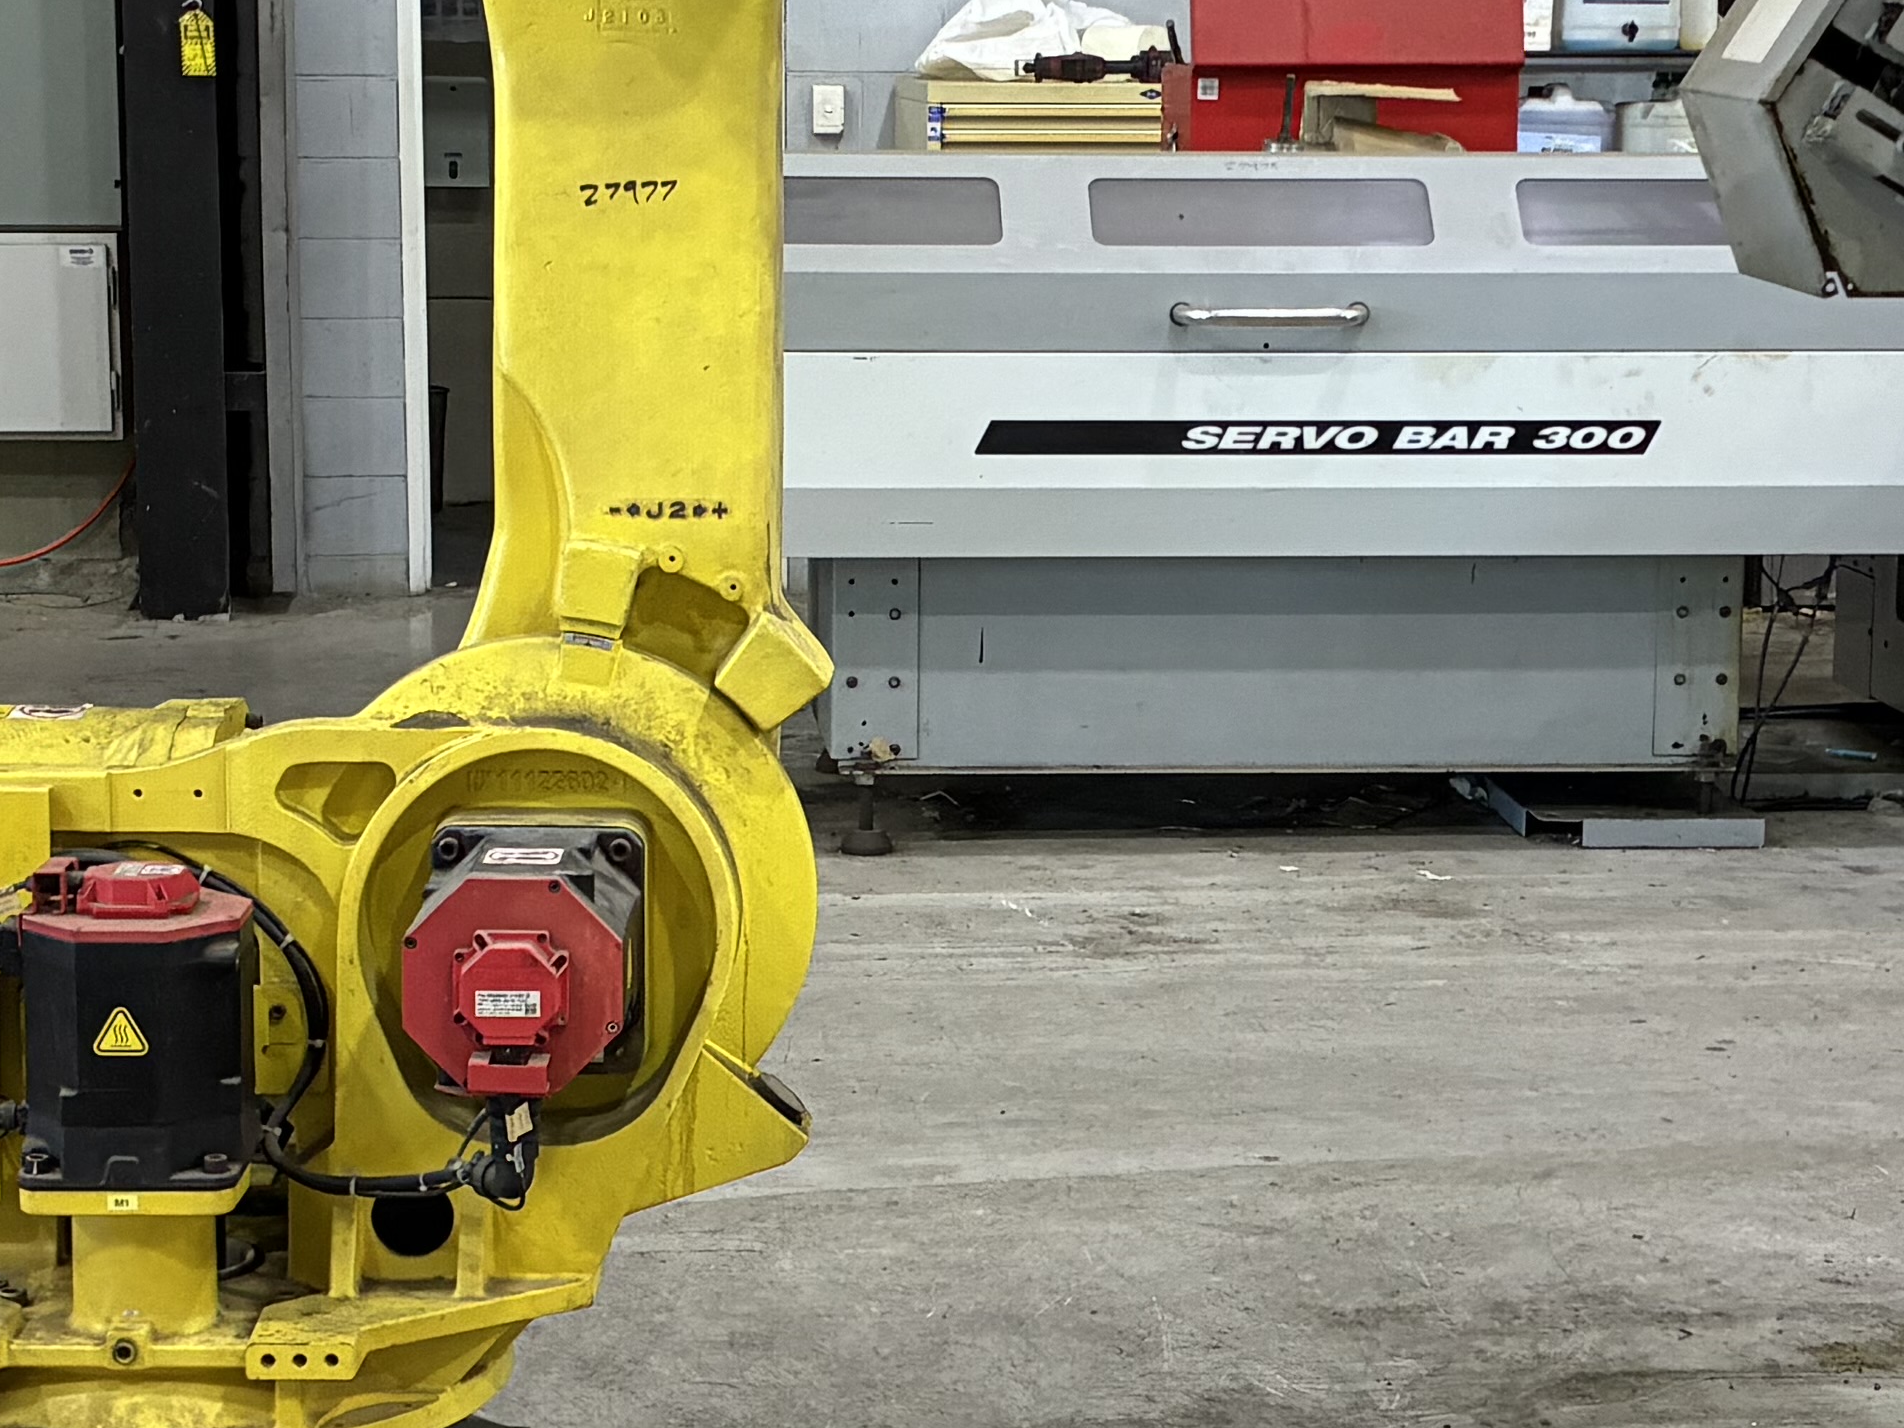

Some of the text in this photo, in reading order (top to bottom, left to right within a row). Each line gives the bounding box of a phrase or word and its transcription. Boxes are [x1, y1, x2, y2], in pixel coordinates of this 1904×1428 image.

[579, 179, 678, 207] 27977
[1181, 425, 1648, 451] SERVO BAR 300
[645, 501, 687, 519] J2
[114, 1198, 129, 1207] M1
